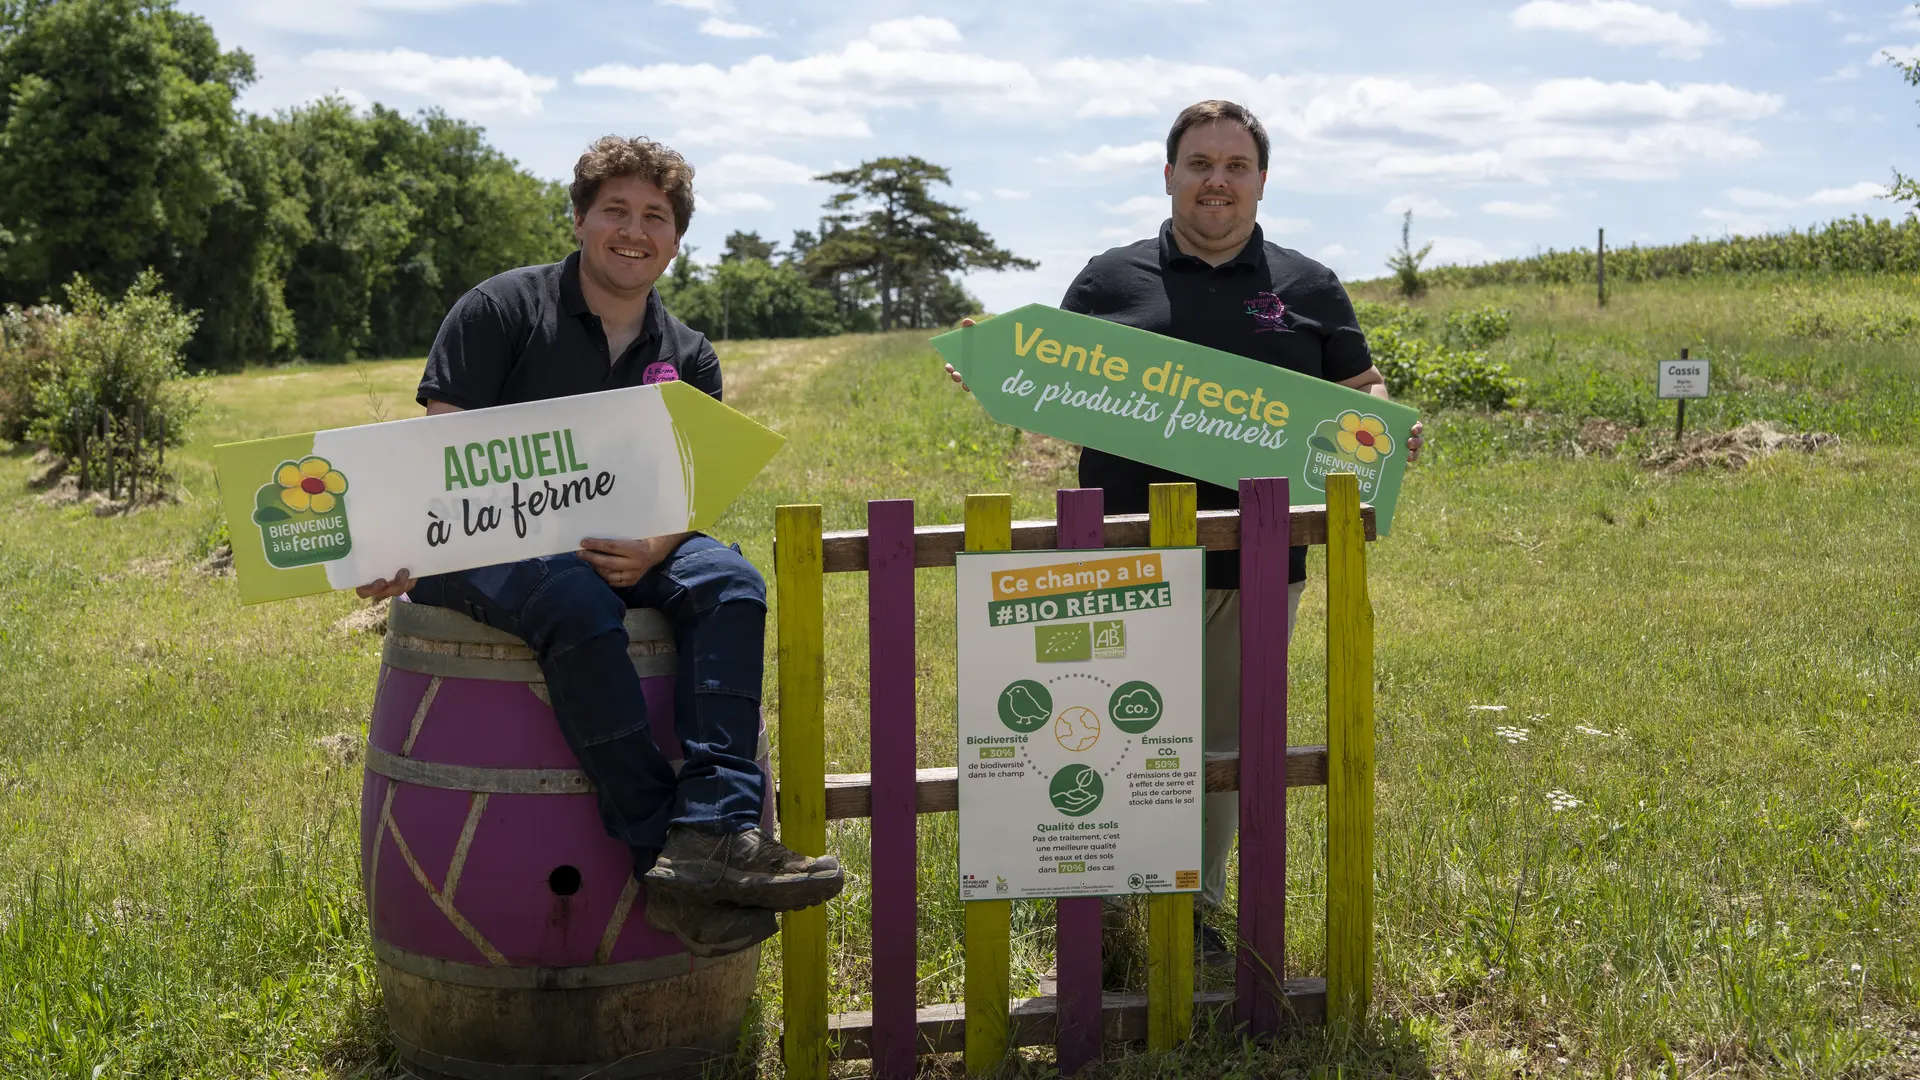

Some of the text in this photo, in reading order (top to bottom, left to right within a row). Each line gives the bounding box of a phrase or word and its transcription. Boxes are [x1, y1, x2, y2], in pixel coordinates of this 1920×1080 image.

[1014, 322, 1290, 427] Vente directe
[1668, 365, 1701, 376] Cassis
[1001, 369, 1288, 450] de produits fermiers
[444, 428, 588, 491] ACCUEIL
[1312, 464, 1319, 474] à
[1315, 452, 1377, 480] BIENVENUE
[426, 468, 616, 547] à la ferme
[269, 515, 344, 540] BIENVENUE
[272, 531, 346, 553] à la ferme
[999, 560, 1156, 594] Ce champ a le
[996, 587, 1171, 625] #BIO RÉFLEXE
[1096, 627, 1120, 647] AB
[966, 734, 1029, 745] Biodiversité
[1141, 734, 1194, 745] Émissions
[989, 749, 1013, 758] 30%
[980, 760, 1025, 769] biodiversité
[1154, 760, 1178, 769] 50%
[968, 770, 1025, 780] dans le champ
[1126, 771, 1170, 779] d'émissions
[1183, 771, 1197, 780] gaz
[1128, 780, 1134, 788] à
[1135, 780, 1153, 788] effet
[1131, 788, 1192, 798] plus de carbone
[1128, 798, 1153, 806] stocké
[1037, 820, 1119, 833] Qualité des sols
[1032, 835, 1047, 843] Pas
[1059, 834, 1102, 842] traitement,
[1103, 832, 1121, 840] c'est
[1052, 843, 1089, 852] meilleure
[1090, 842, 1117, 852] qualité
[1039, 854, 1053, 862] des
[1099, 852, 1114, 860] sols
[1038, 866, 1057, 874] dans
[1060, 864, 1083, 873] 70%
[1087, 864, 1101, 872] des
